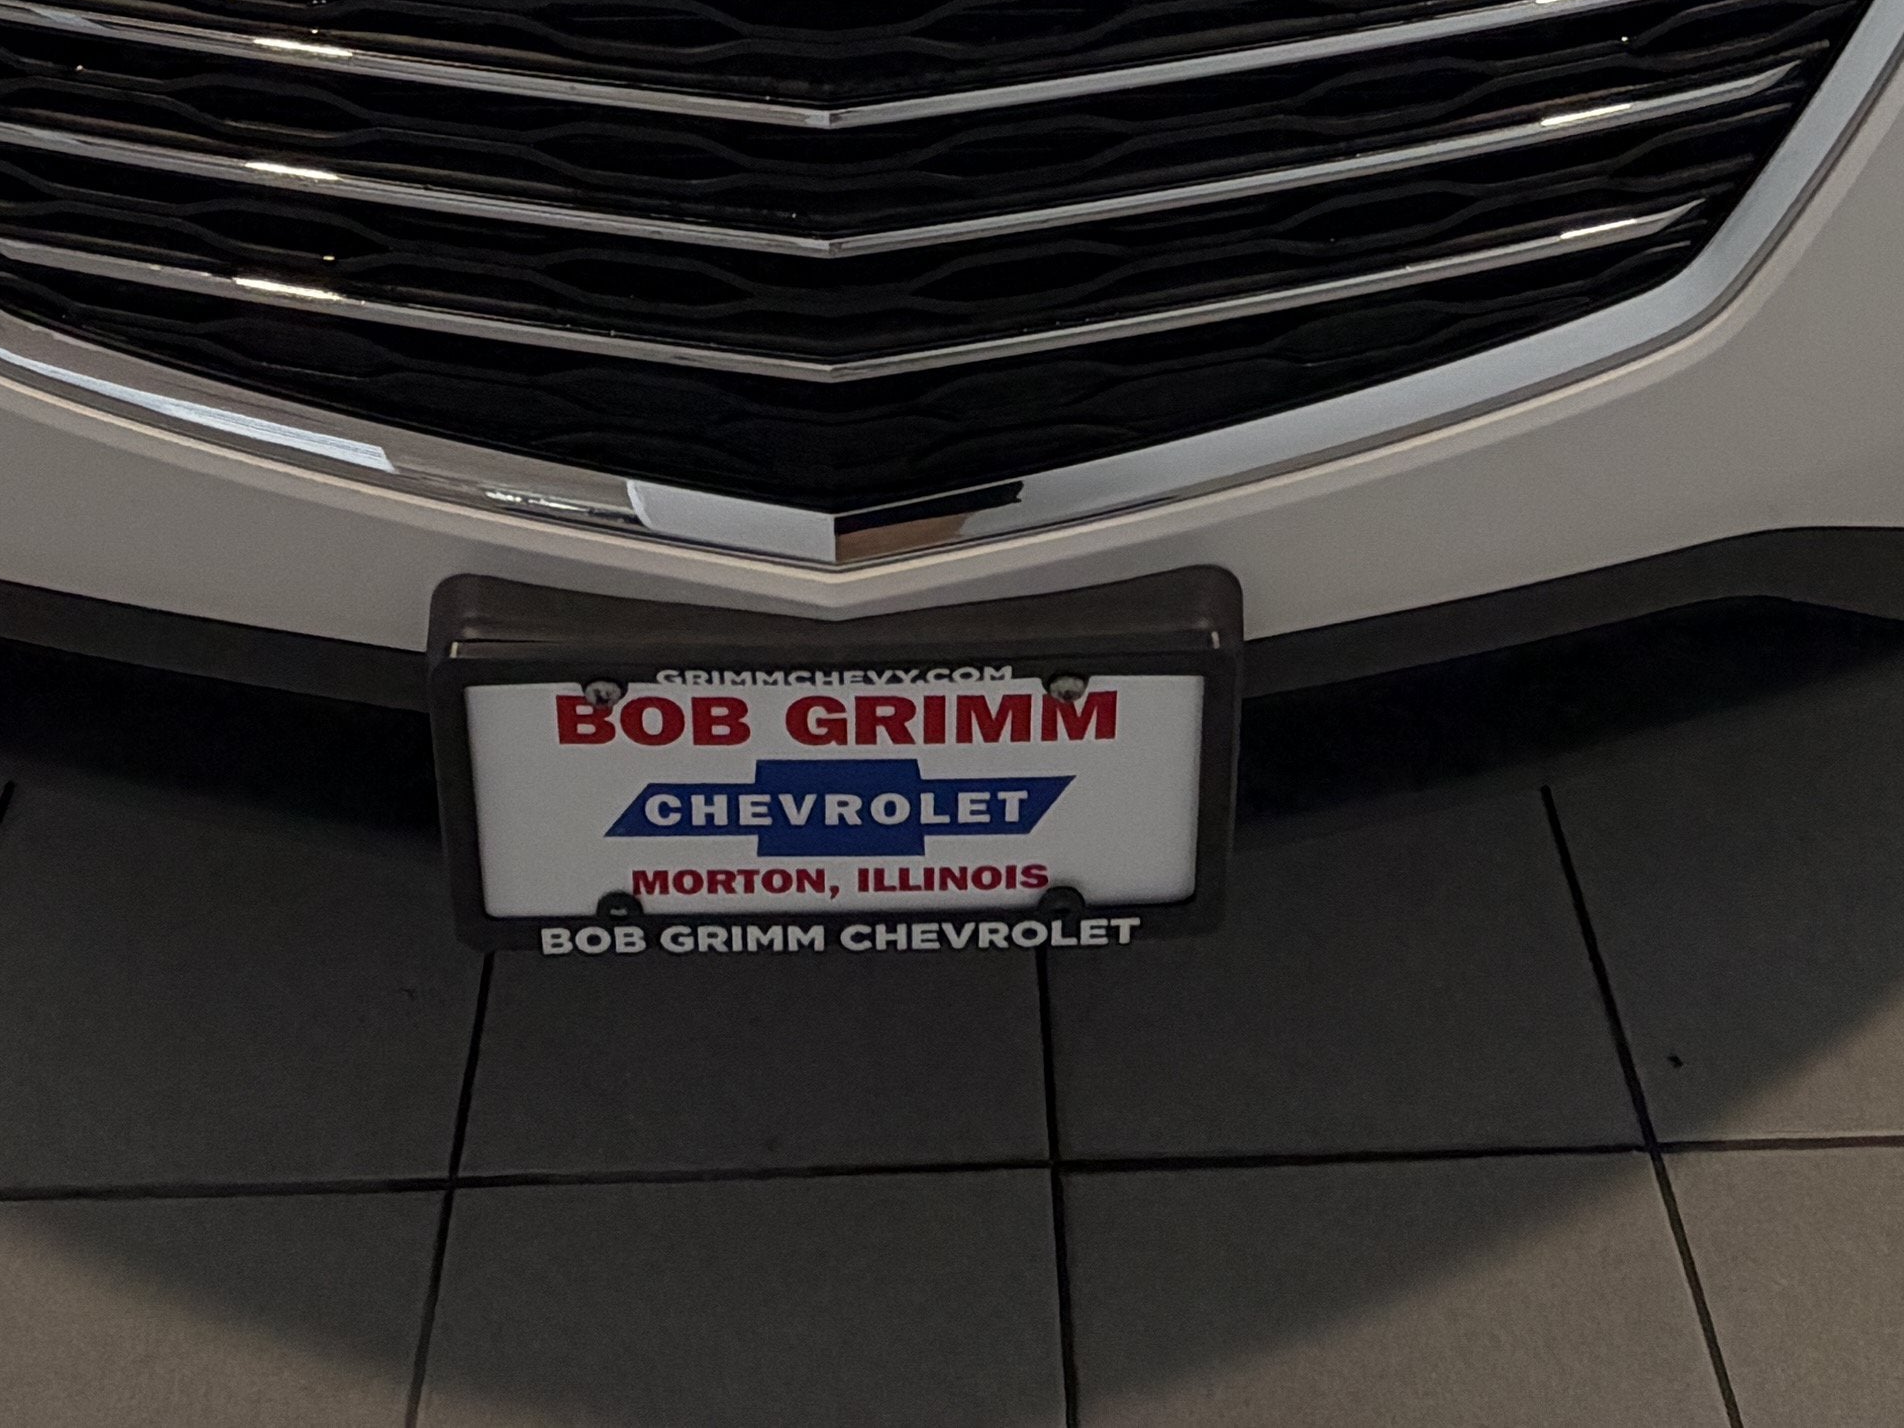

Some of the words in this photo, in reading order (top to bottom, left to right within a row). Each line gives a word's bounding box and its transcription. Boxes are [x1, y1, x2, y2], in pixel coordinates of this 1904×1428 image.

[655, 665, 1013, 687] GRIMMCHEVY.COM
[556, 695, 751, 746] BOB
[785, 691, 1118, 746] GRIMM
[645, 790, 1028, 827] CHEVROLET
[632, 868, 840, 900] MORTON,
[857, 864, 1049, 893] ILLINOIS
[541, 926, 647, 955] BOB
[659, 925, 825, 954] GRIMM
[840, 917, 1141, 952] CHEVROLET
